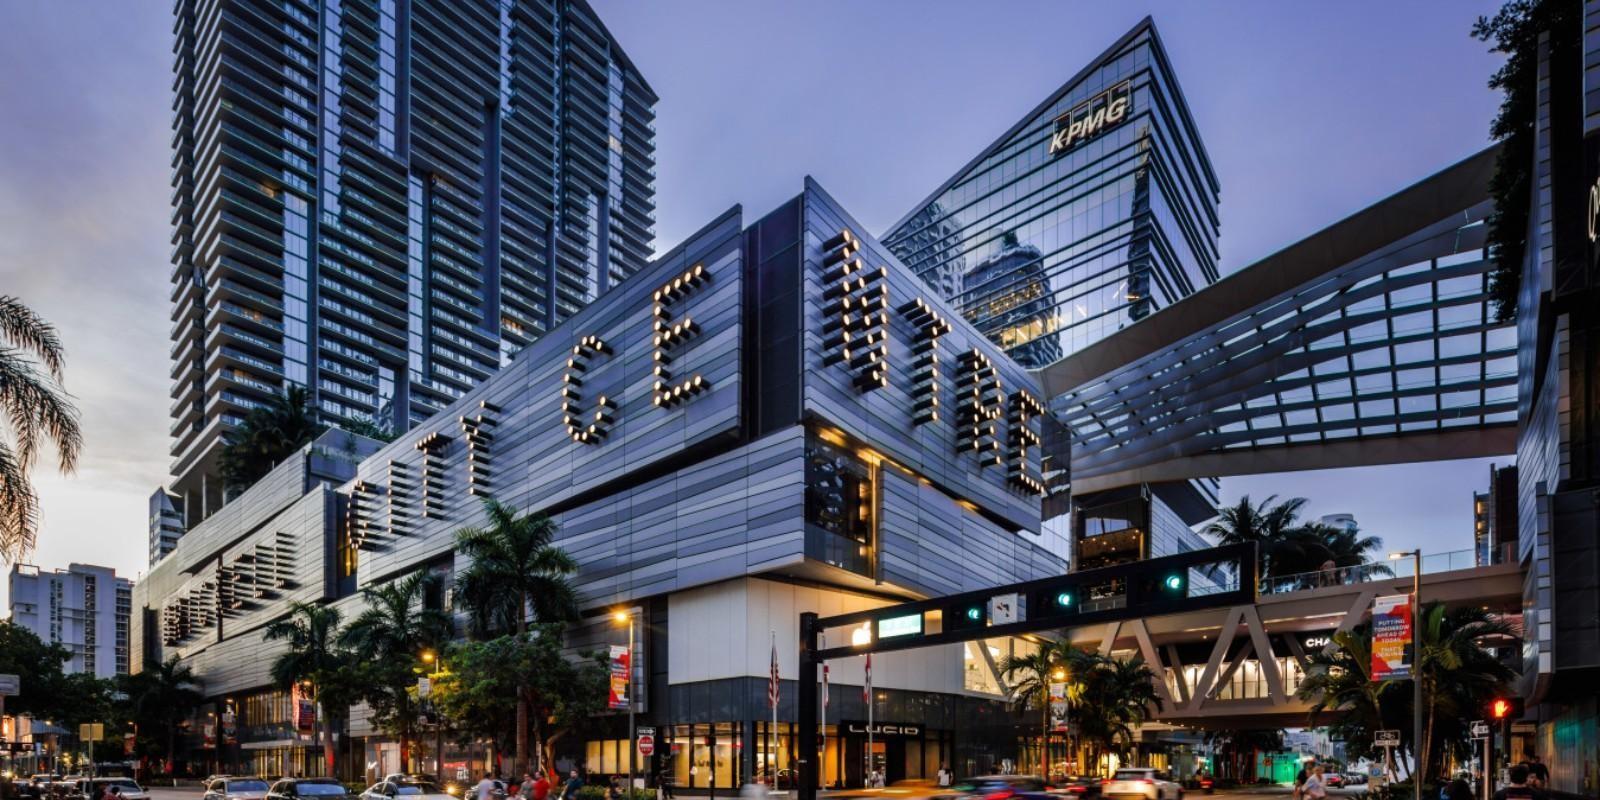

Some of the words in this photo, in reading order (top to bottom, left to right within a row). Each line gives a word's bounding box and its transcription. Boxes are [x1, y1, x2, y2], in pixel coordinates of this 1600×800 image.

[1049, 96, 1127, 154] KPMG
[346, 400, 502, 552] CITY
[1374, 624, 1409, 632] TOMORROW
[1378, 619, 1406, 627] PUTTING
[849, 725, 918, 735] LUCID
